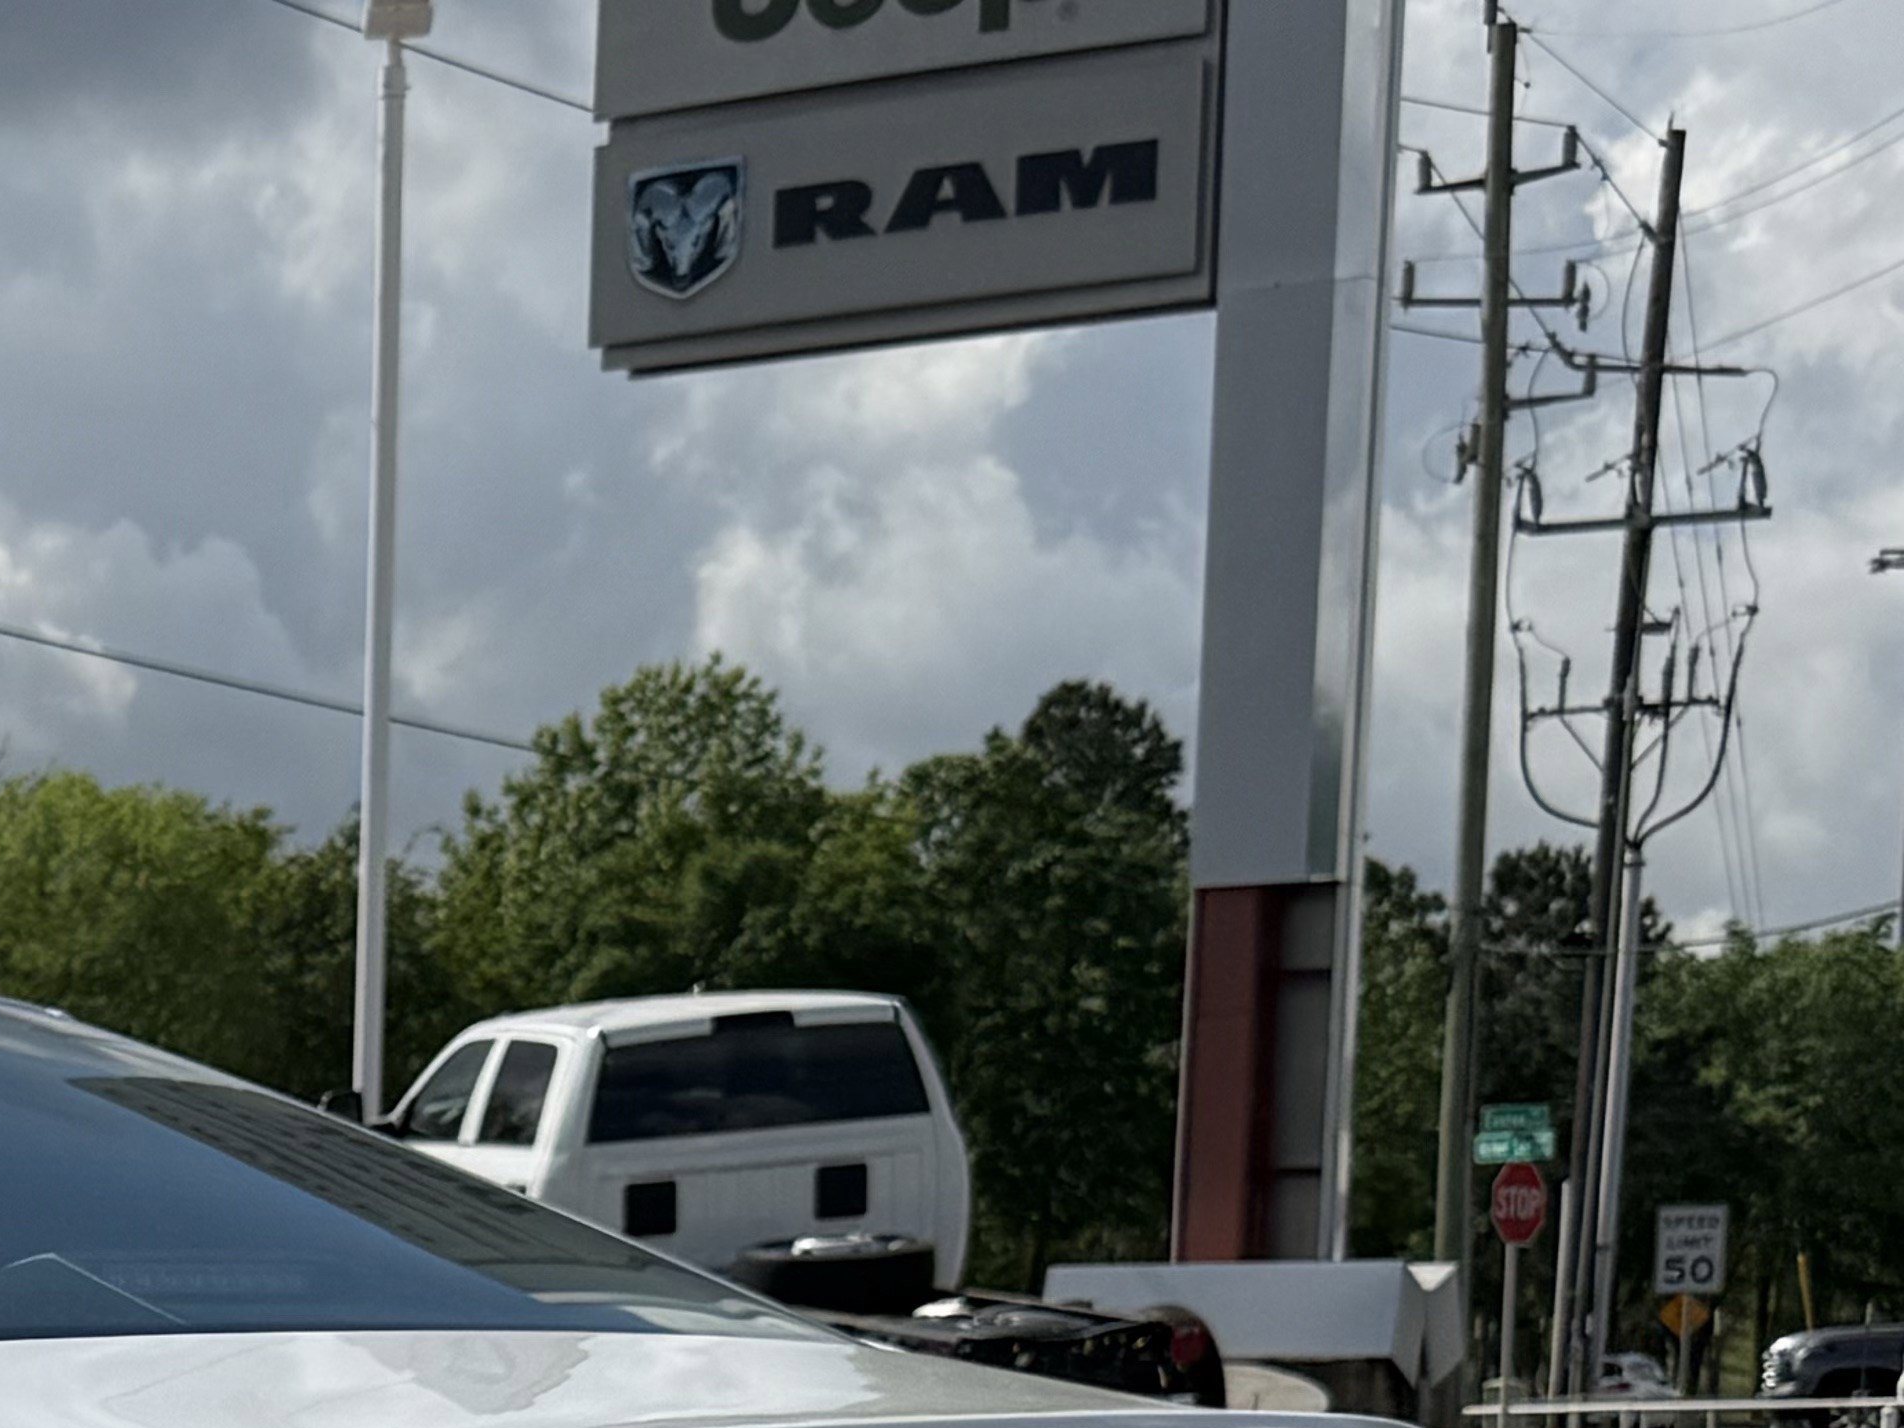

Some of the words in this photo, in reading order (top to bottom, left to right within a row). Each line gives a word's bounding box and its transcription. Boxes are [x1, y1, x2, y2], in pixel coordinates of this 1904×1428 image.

[772, 137, 1160, 250] RAM
[1495, 1185, 1542, 1220] STOP
[1663, 1214, 1721, 1230] SPEED
[1666, 1234, 1714, 1250] LIMIT
[1663, 1255, 1714, 1285] 50
